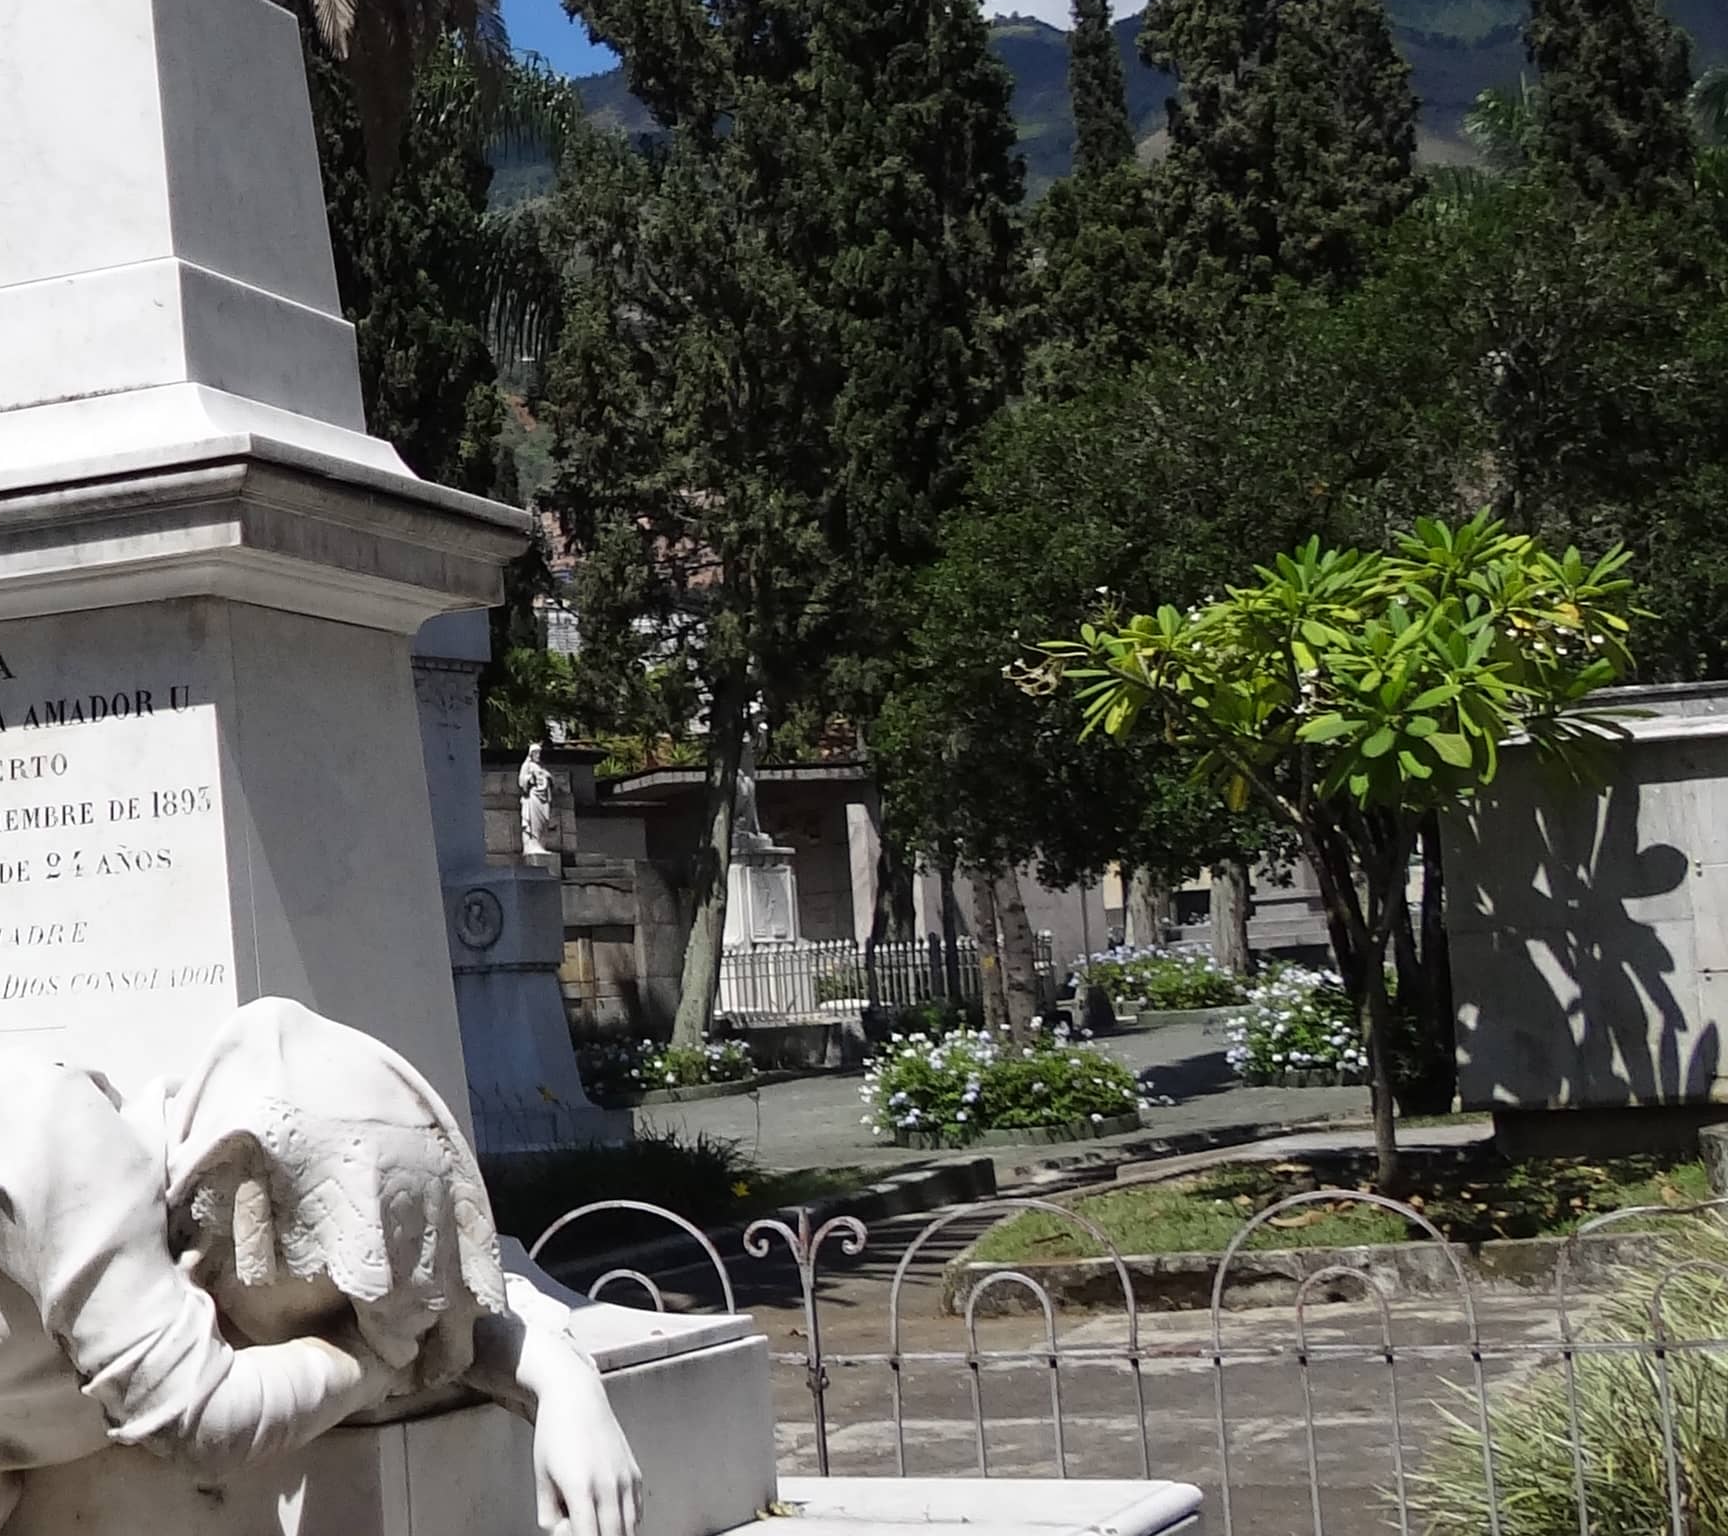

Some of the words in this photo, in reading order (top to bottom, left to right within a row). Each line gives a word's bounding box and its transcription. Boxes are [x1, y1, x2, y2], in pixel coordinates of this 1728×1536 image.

[23, 689, 154, 730] AMADOR
[108, 796, 142, 823] DE
[0, 859, 31, 884] DE
[96, 845, 173, 876] AÑOS
[0, 971, 61, 1002] DIOS
